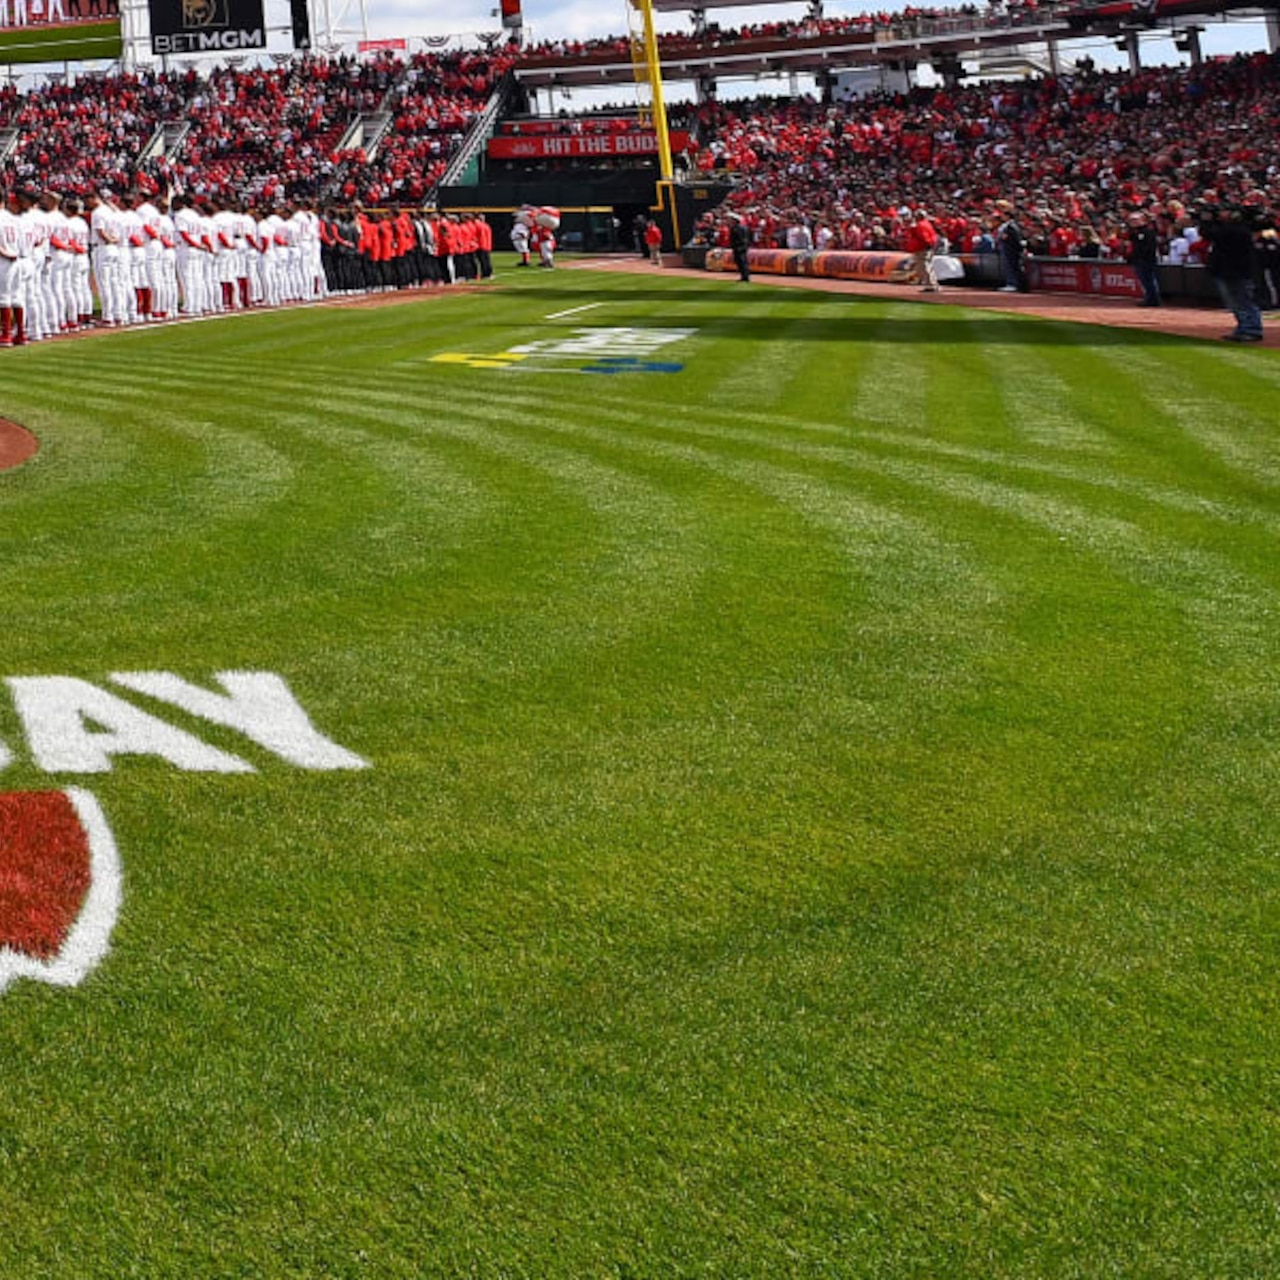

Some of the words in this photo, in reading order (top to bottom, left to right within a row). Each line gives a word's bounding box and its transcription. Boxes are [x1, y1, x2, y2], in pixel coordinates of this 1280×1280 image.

[154, 28, 262, 53] BETMGM
[542, 136, 573, 155] HIT
[577, 135, 610, 154] THE
